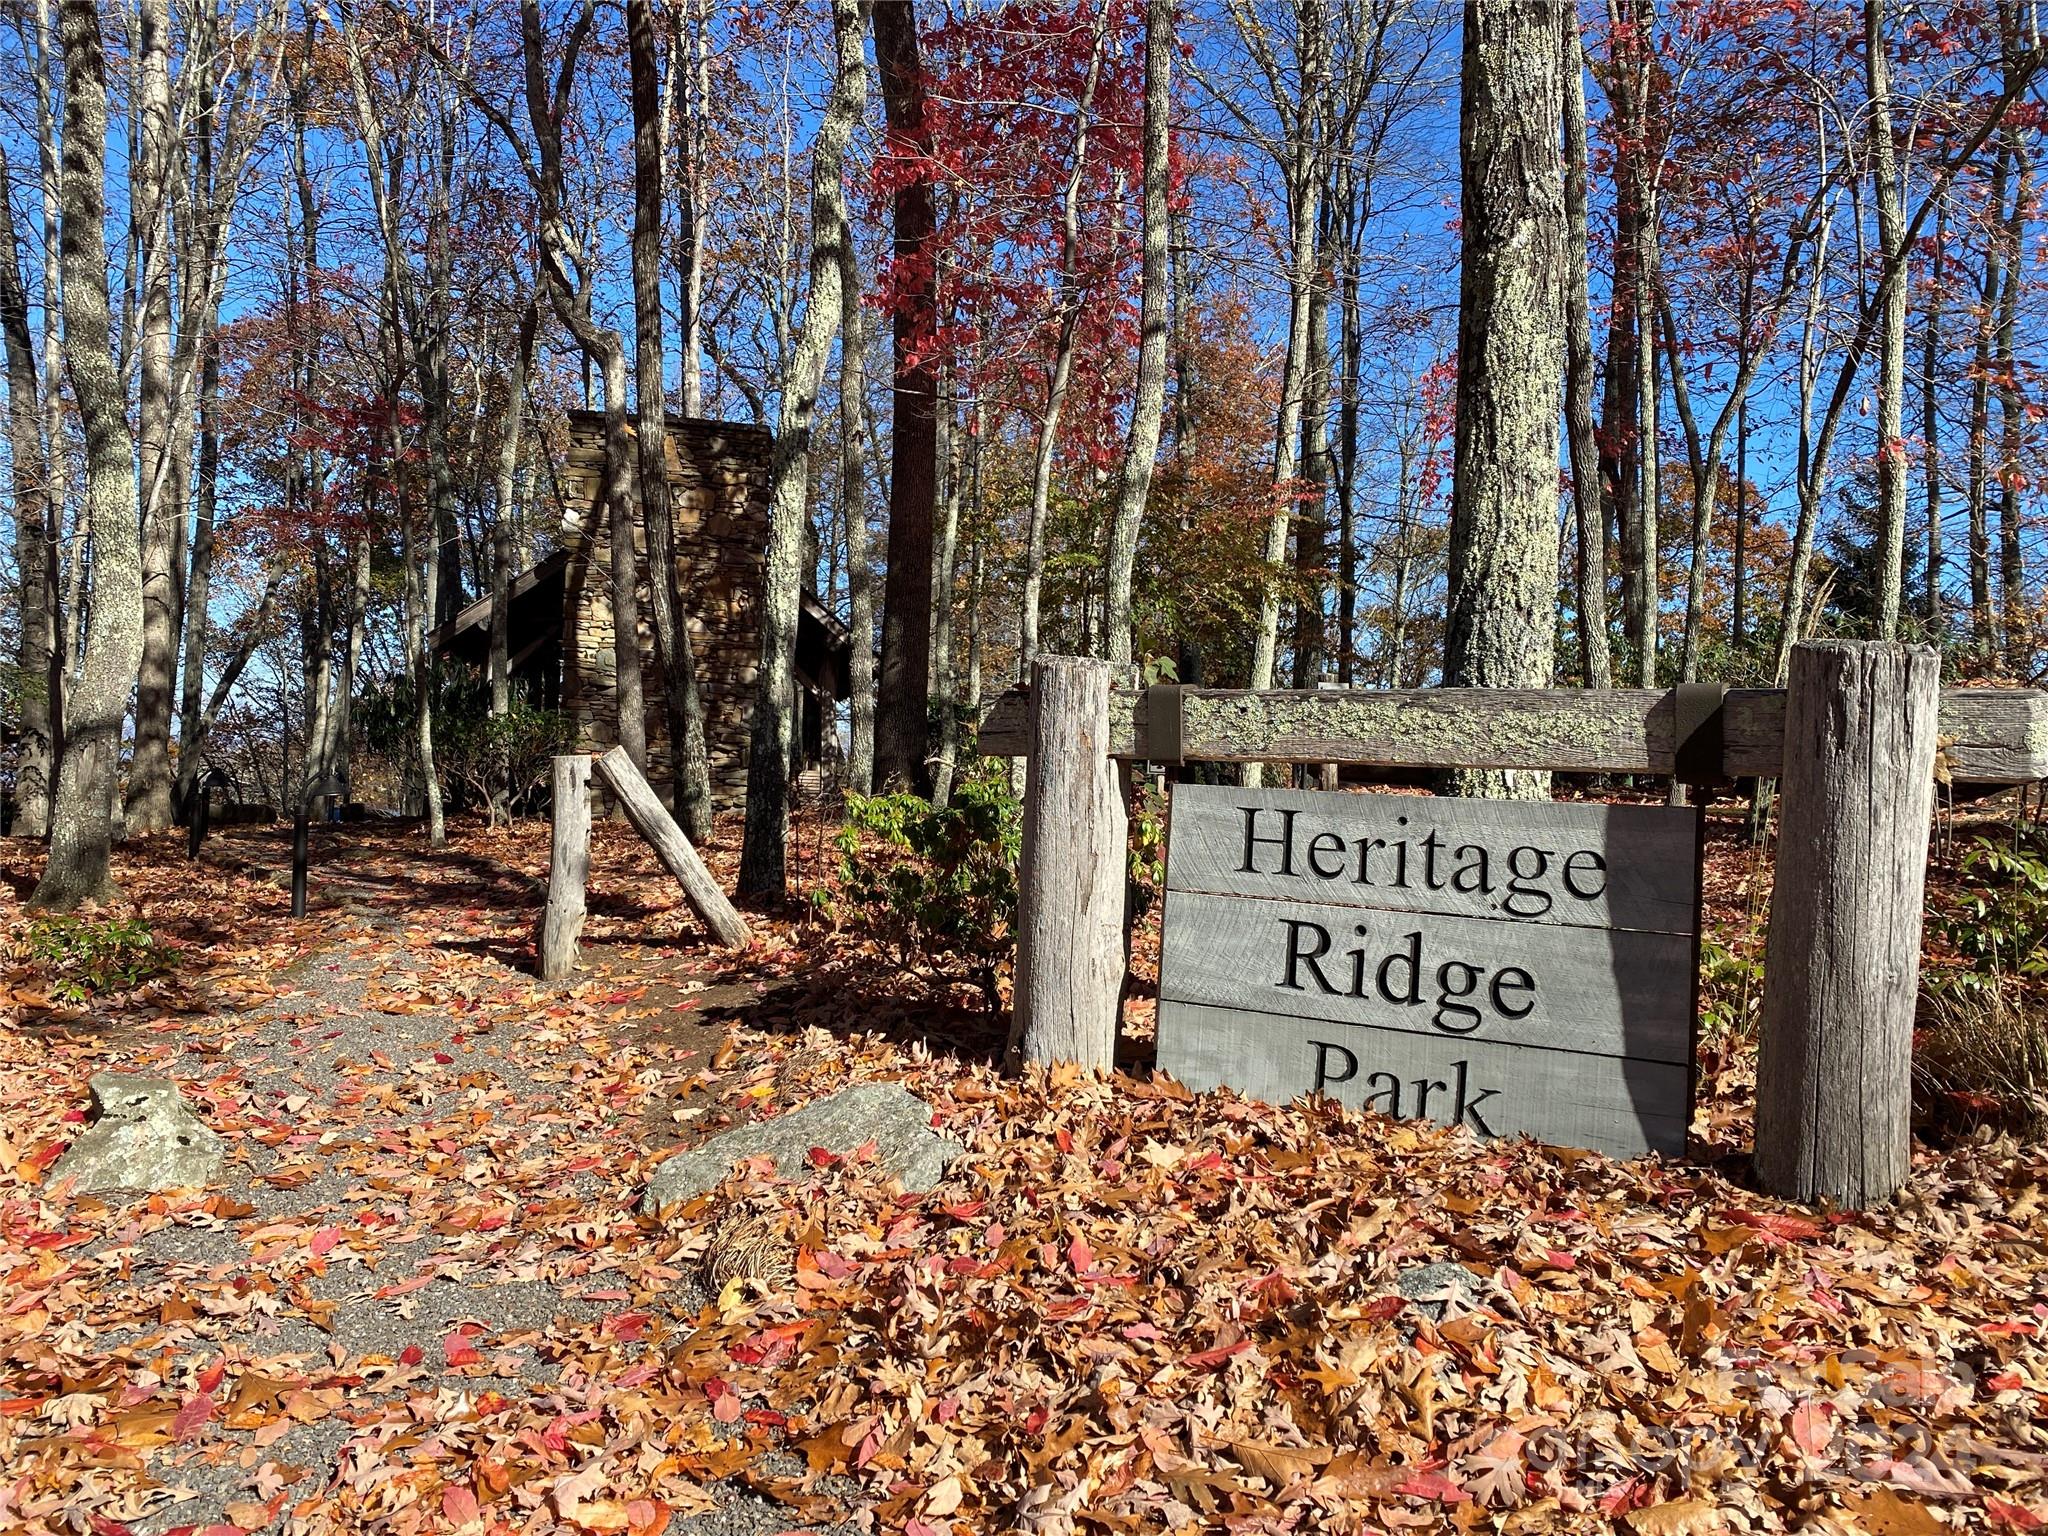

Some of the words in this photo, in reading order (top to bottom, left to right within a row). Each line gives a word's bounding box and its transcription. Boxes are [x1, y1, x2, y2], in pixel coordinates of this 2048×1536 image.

[1234, 806, 1608, 918] Heritage
[1275, 918, 1536, 1035] Ridge
[1307, 1040, 1502, 1139] Park
